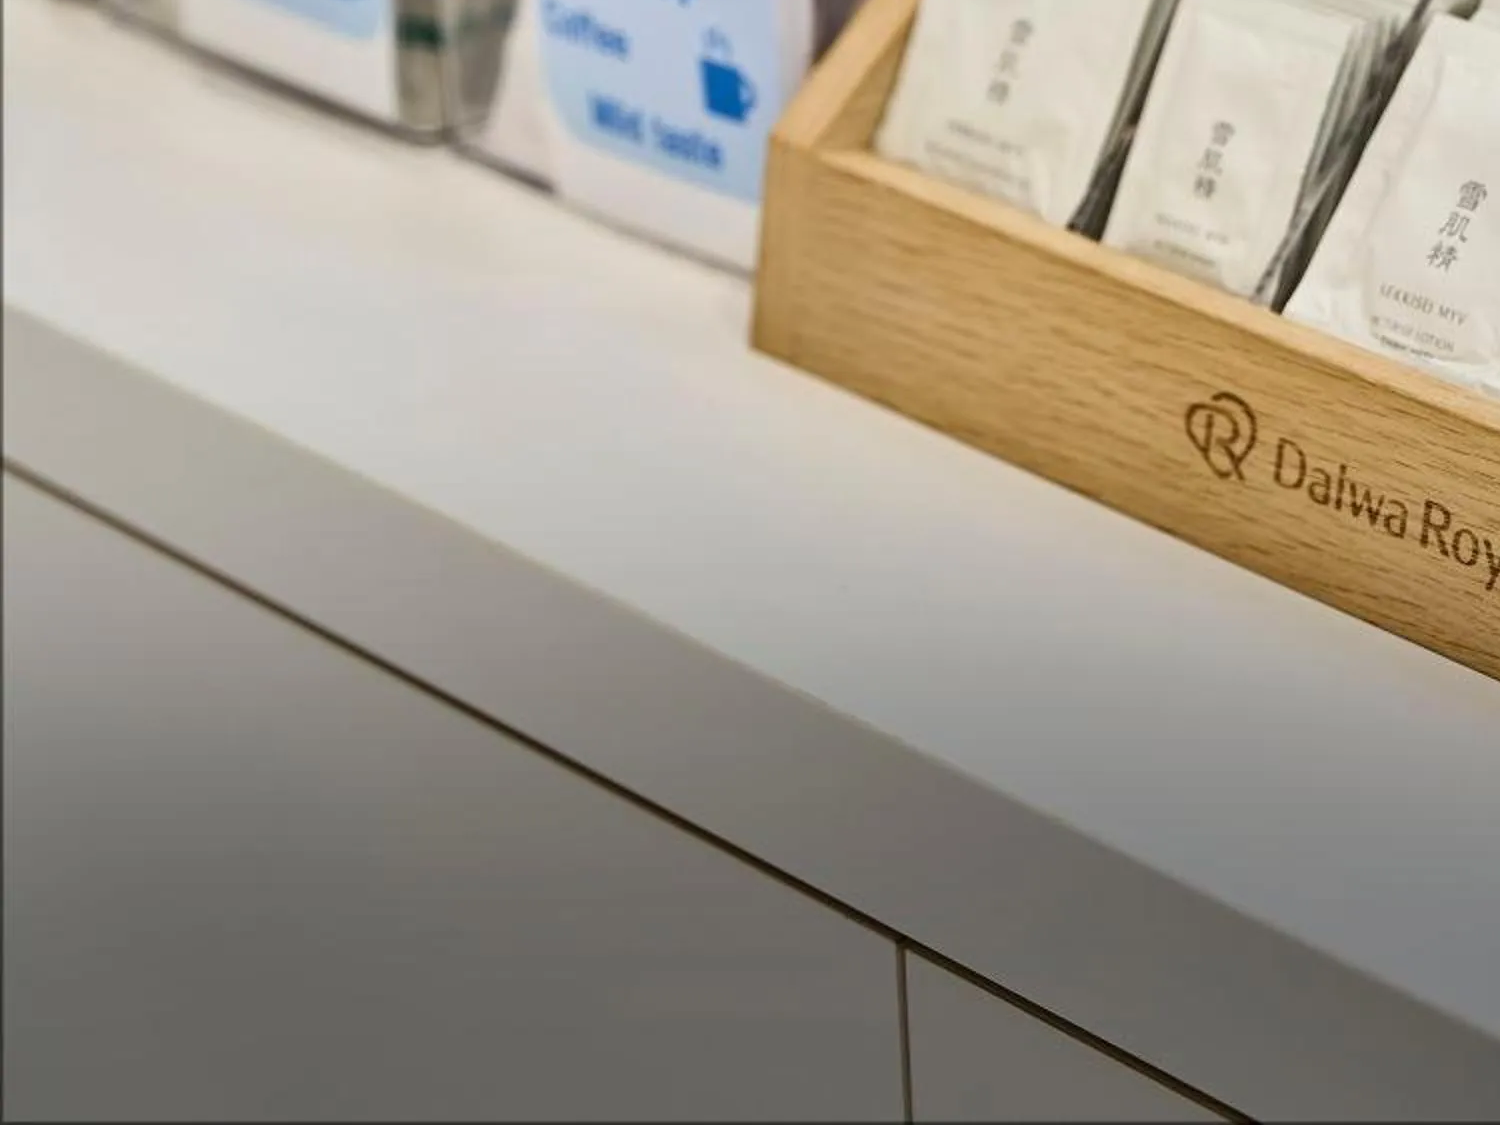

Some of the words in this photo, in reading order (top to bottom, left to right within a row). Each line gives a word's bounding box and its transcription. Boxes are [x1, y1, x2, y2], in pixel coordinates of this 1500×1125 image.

[1426, 178, 1488, 274] 雪肌精
[1272, 436, 1409, 540] Daiwa
